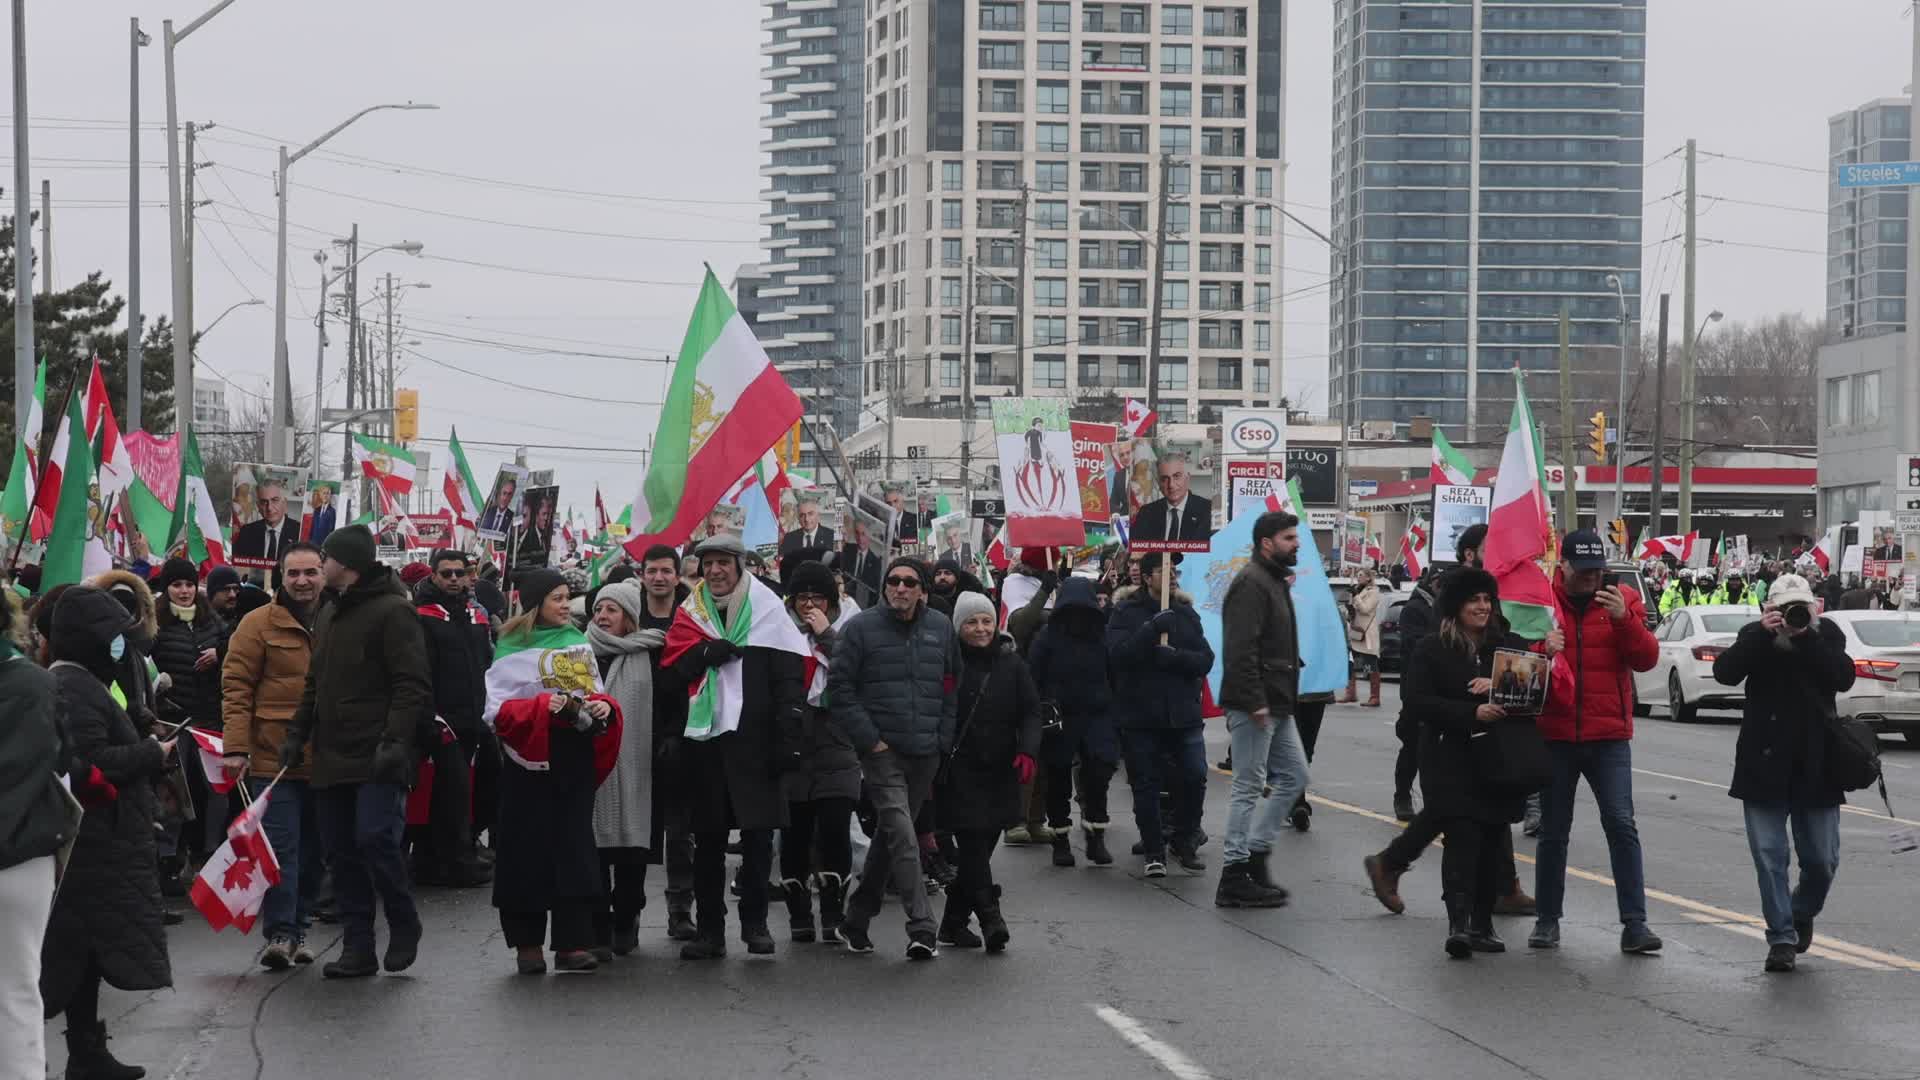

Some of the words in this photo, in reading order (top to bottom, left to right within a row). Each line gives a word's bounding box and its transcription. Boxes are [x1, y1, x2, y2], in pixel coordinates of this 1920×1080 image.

[1848, 164, 1901, 182] Steeles
[1240, 426, 1272, 441] Esso
[1072, 436, 1104, 455] gim
[1286, 448, 1328, 465] TTOO
[1072, 457, 1105, 473] ange
[1229, 467, 1265, 477] CIRCLE
[1270, 467, 1280, 478] K
[1246, 480, 1272, 489] REZA
[1240, 488, 1267, 497] SHAH
[1449, 487, 1477, 496] REZA
[1442, 495, 1471, 504] SHAH
[1474, 496, 1483, 505] II
